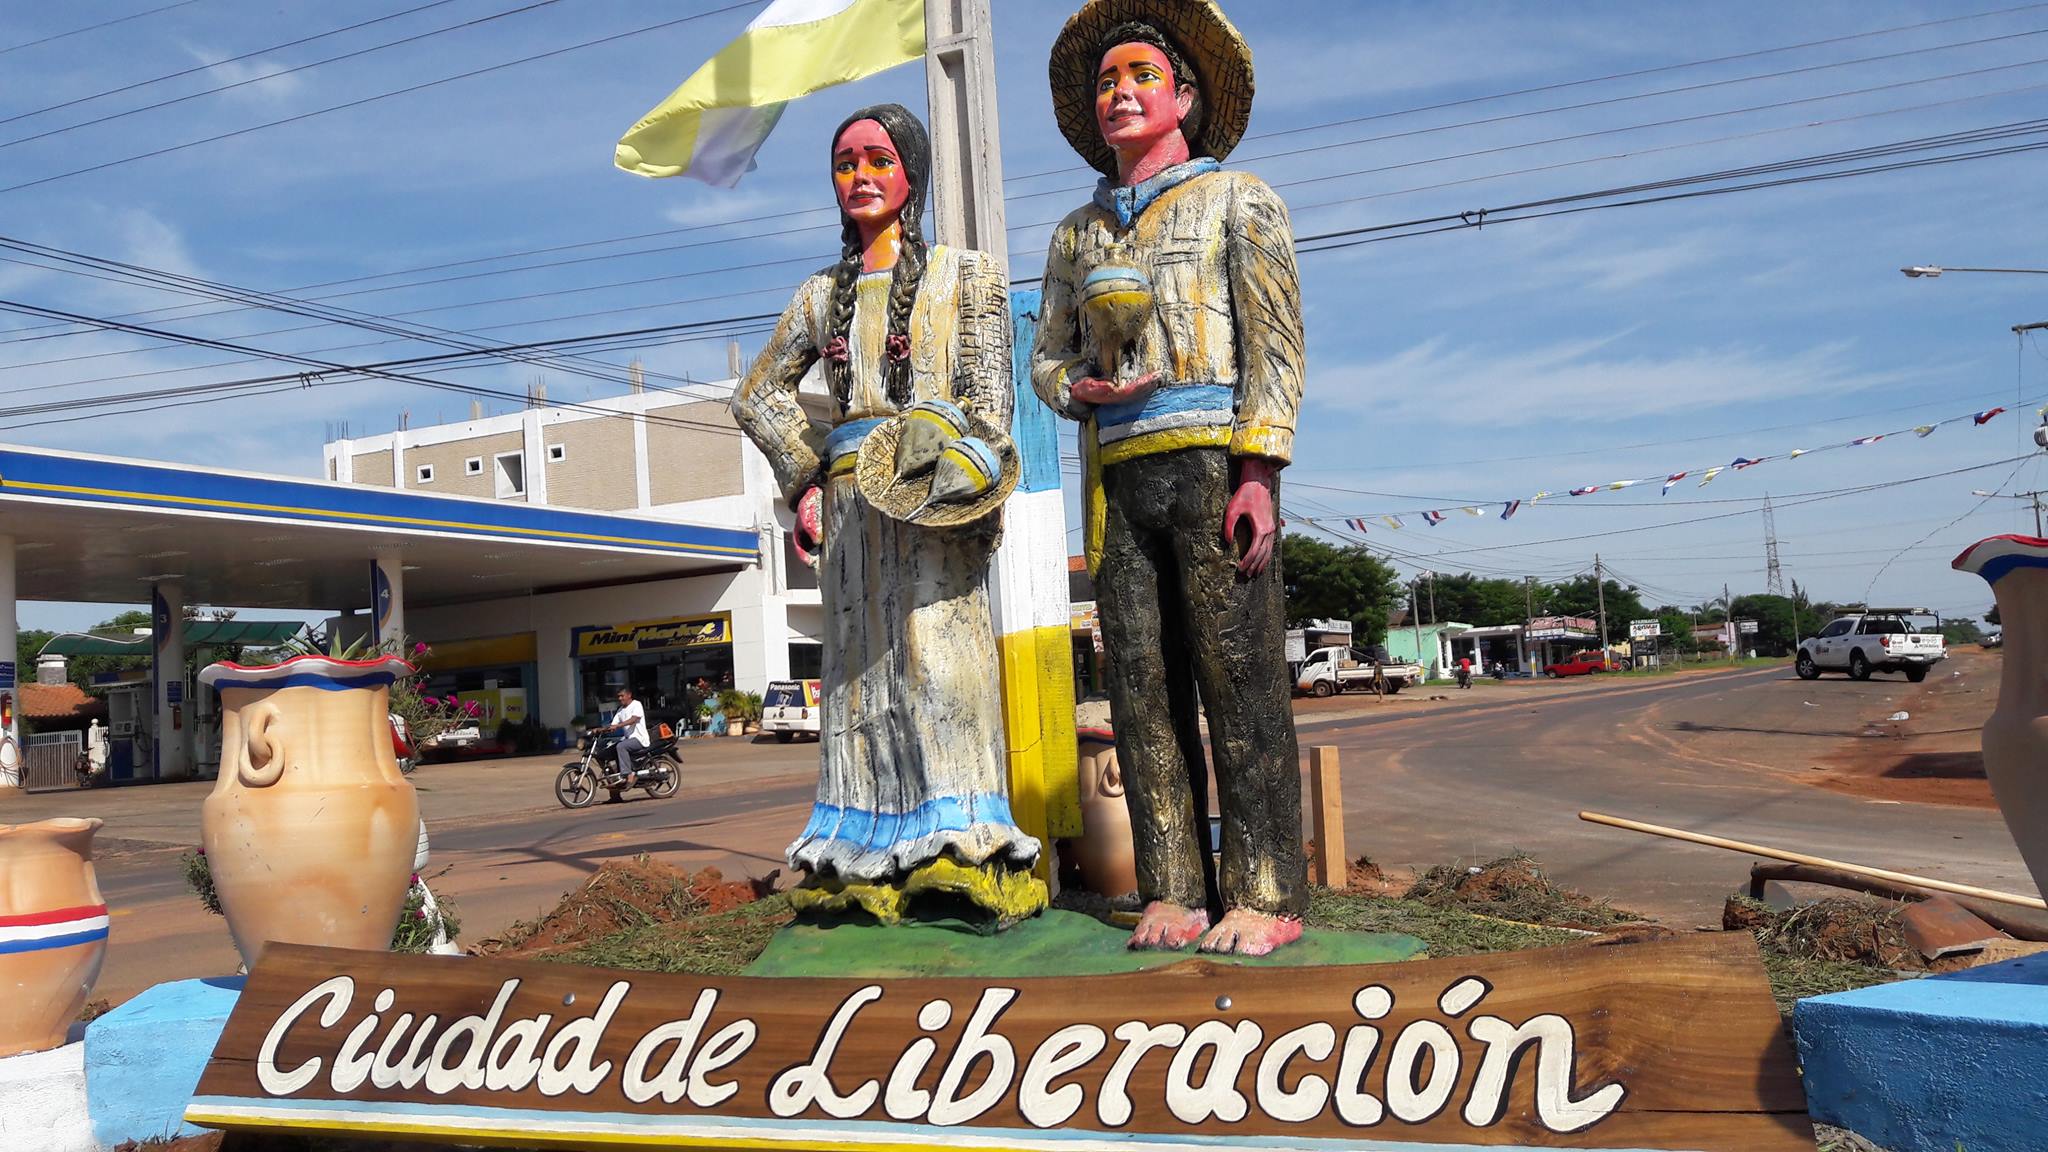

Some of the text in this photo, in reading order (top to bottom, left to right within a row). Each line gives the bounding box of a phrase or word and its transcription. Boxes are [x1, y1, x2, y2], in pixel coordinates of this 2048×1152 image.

[380, 589, 390, 599] 4
[160, 614, 168, 624] 3
[588, 620, 716, 646] Mini Market
[770, 682, 801, 691] Panasonic
[256, 975, 1626, 1134] Ciudad de Liberación
